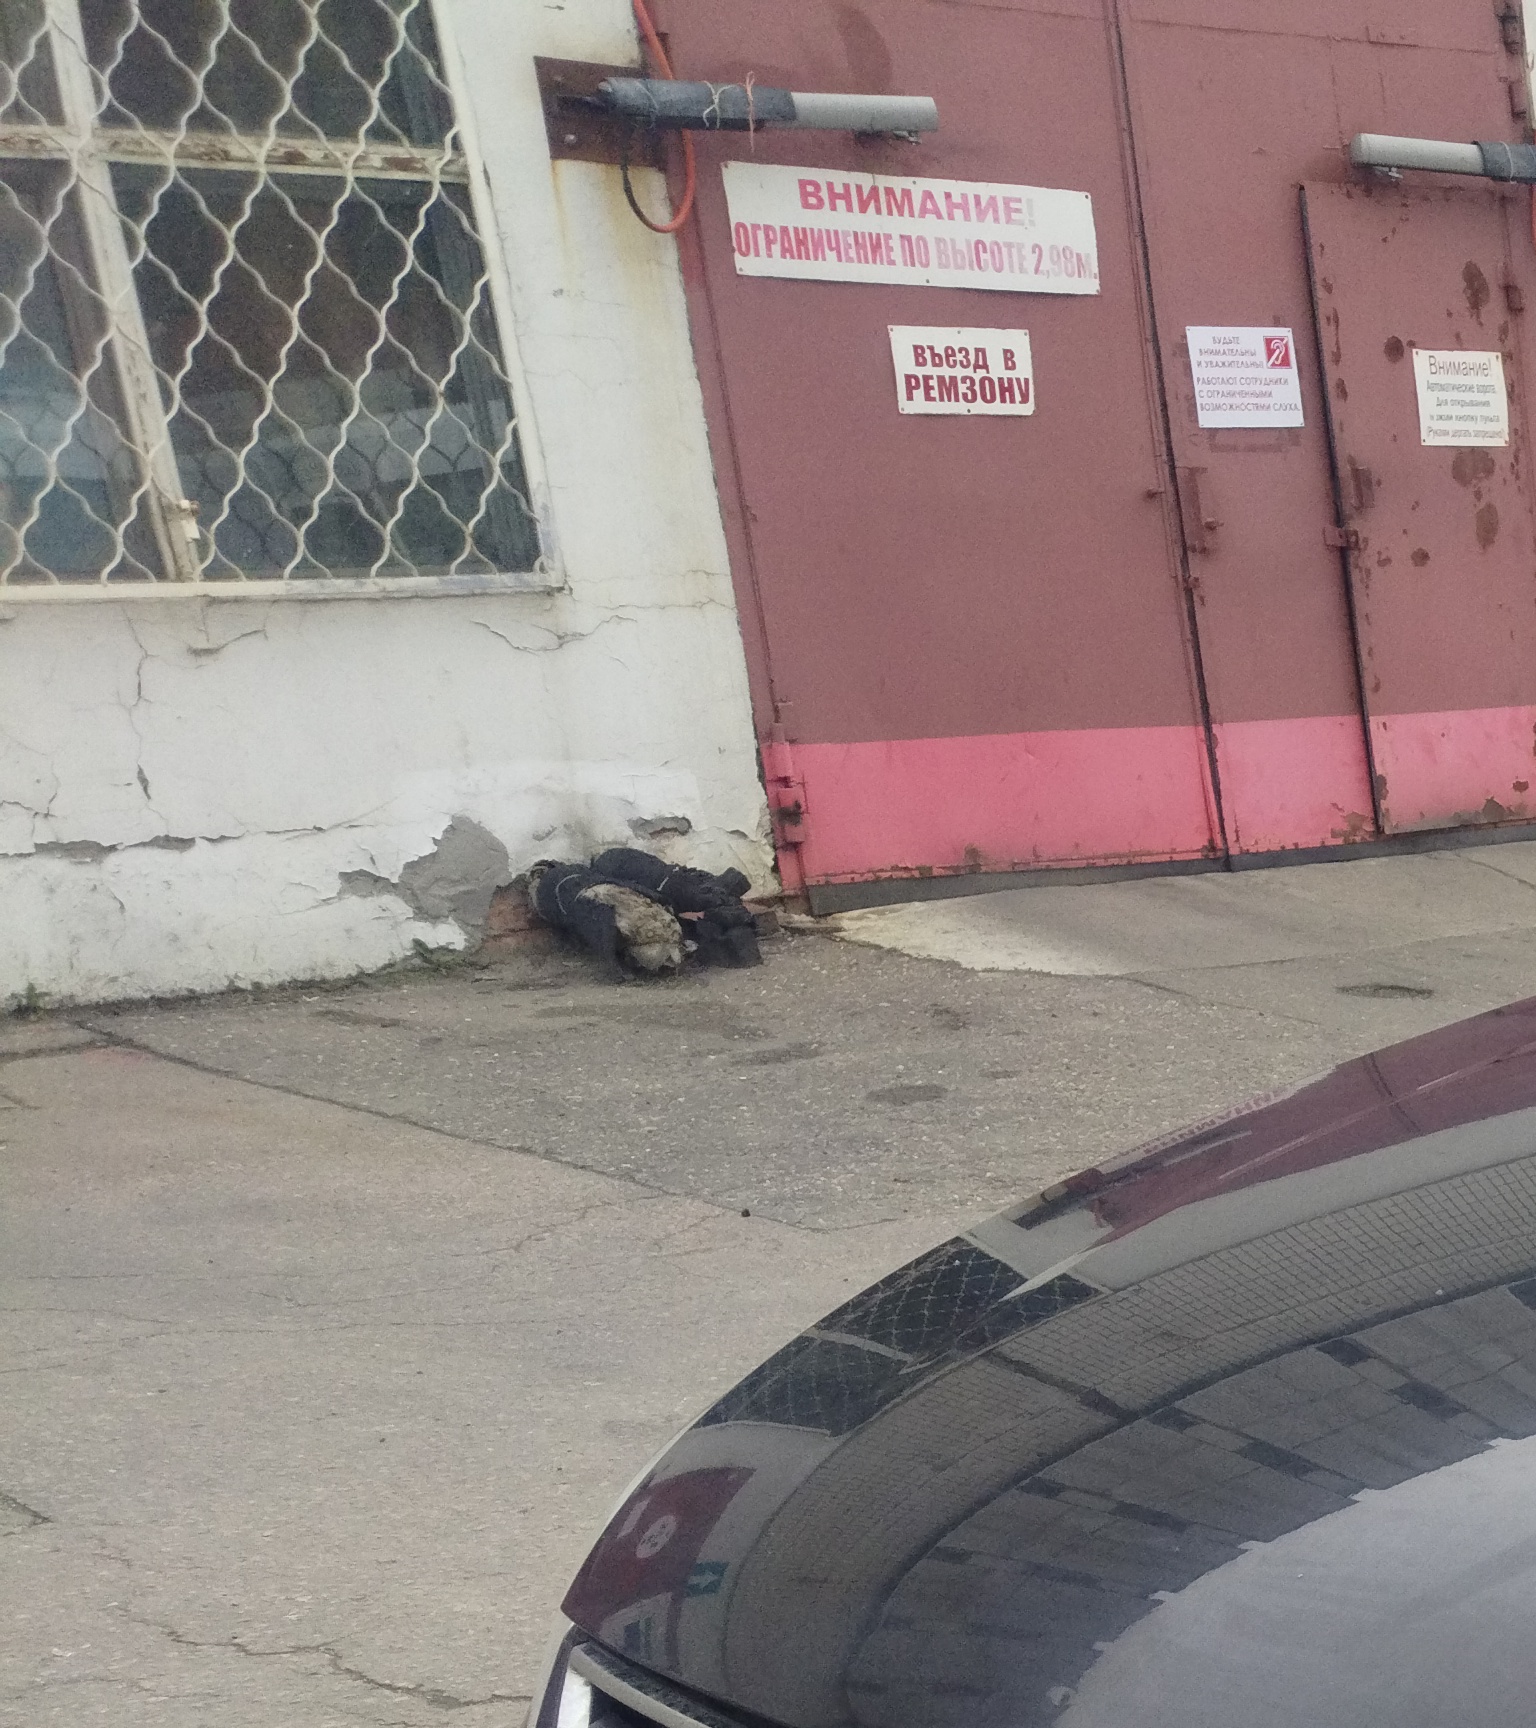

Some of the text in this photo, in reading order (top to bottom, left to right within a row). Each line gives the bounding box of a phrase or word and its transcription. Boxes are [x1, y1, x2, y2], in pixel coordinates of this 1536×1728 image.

[798, 179, 1036, 227] ВНИМАНИЕ!
[734, 221, 896, 267] ОГРАНИЧЕНИЕ
[900, 234, 930, 269] ПО
[934, 236, 1027, 274] ВЫСОТЕ
[1197, 377, 1289, 386] РАБОТАЮТ СОТРУДНИКИ
[1428, 355, 1492, 377] Внимание!
[904, 373, 1030, 404] РЕМЗОНУ
